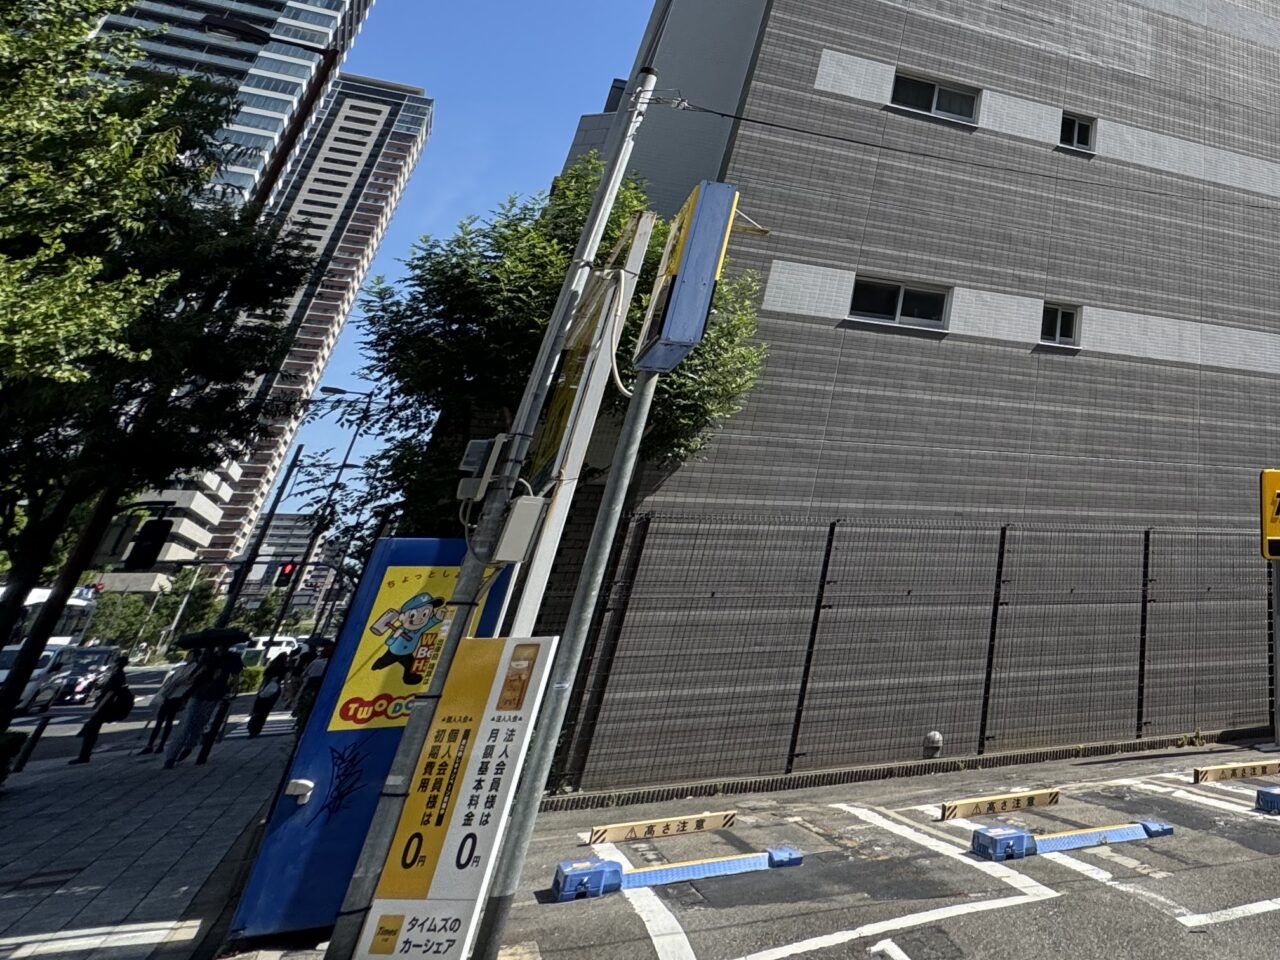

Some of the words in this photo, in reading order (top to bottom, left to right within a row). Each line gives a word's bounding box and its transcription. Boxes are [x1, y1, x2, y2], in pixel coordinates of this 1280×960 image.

[417, 728, 447, 793] 初期費用
[420, 728, 460, 826] 個人会員様は
[461, 728, 500, 827] 月額基本料金
[479, 727, 517, 826] 法人会員様は
[986, 796, 1036, 814] 高さ注意
[643, 818, 706, 838] 高さ注意
[406, 916, 462, 934] タイムズの
[399, 938, 457, 955] カーシェア
